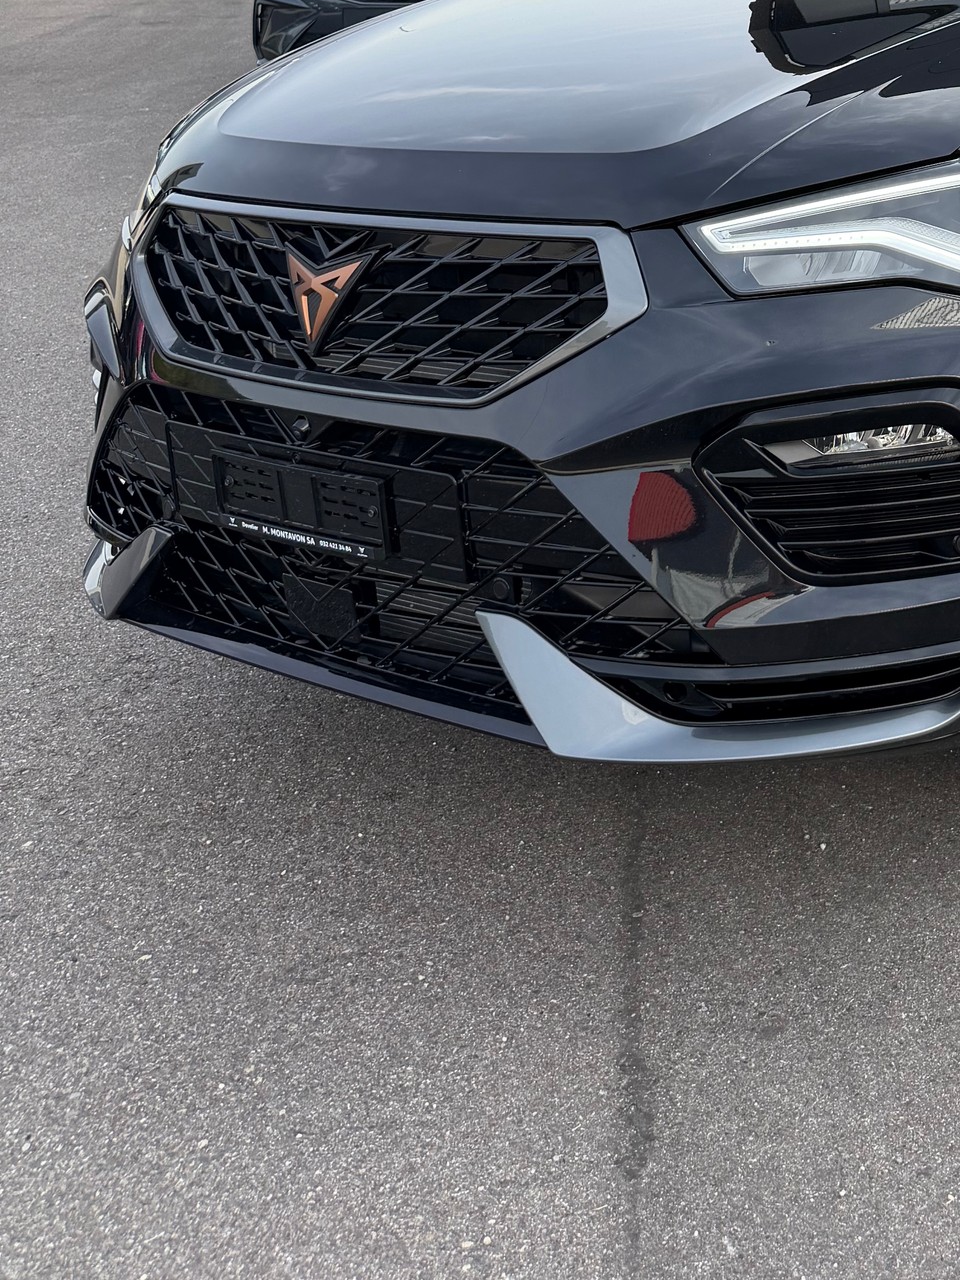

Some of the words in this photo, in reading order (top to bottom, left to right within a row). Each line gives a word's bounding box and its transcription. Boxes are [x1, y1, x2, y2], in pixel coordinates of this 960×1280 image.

[262, 525, 270, 535] M.
[270, 527, 305, 543] MONTAVON
[306, 536, 316, 546] SA
